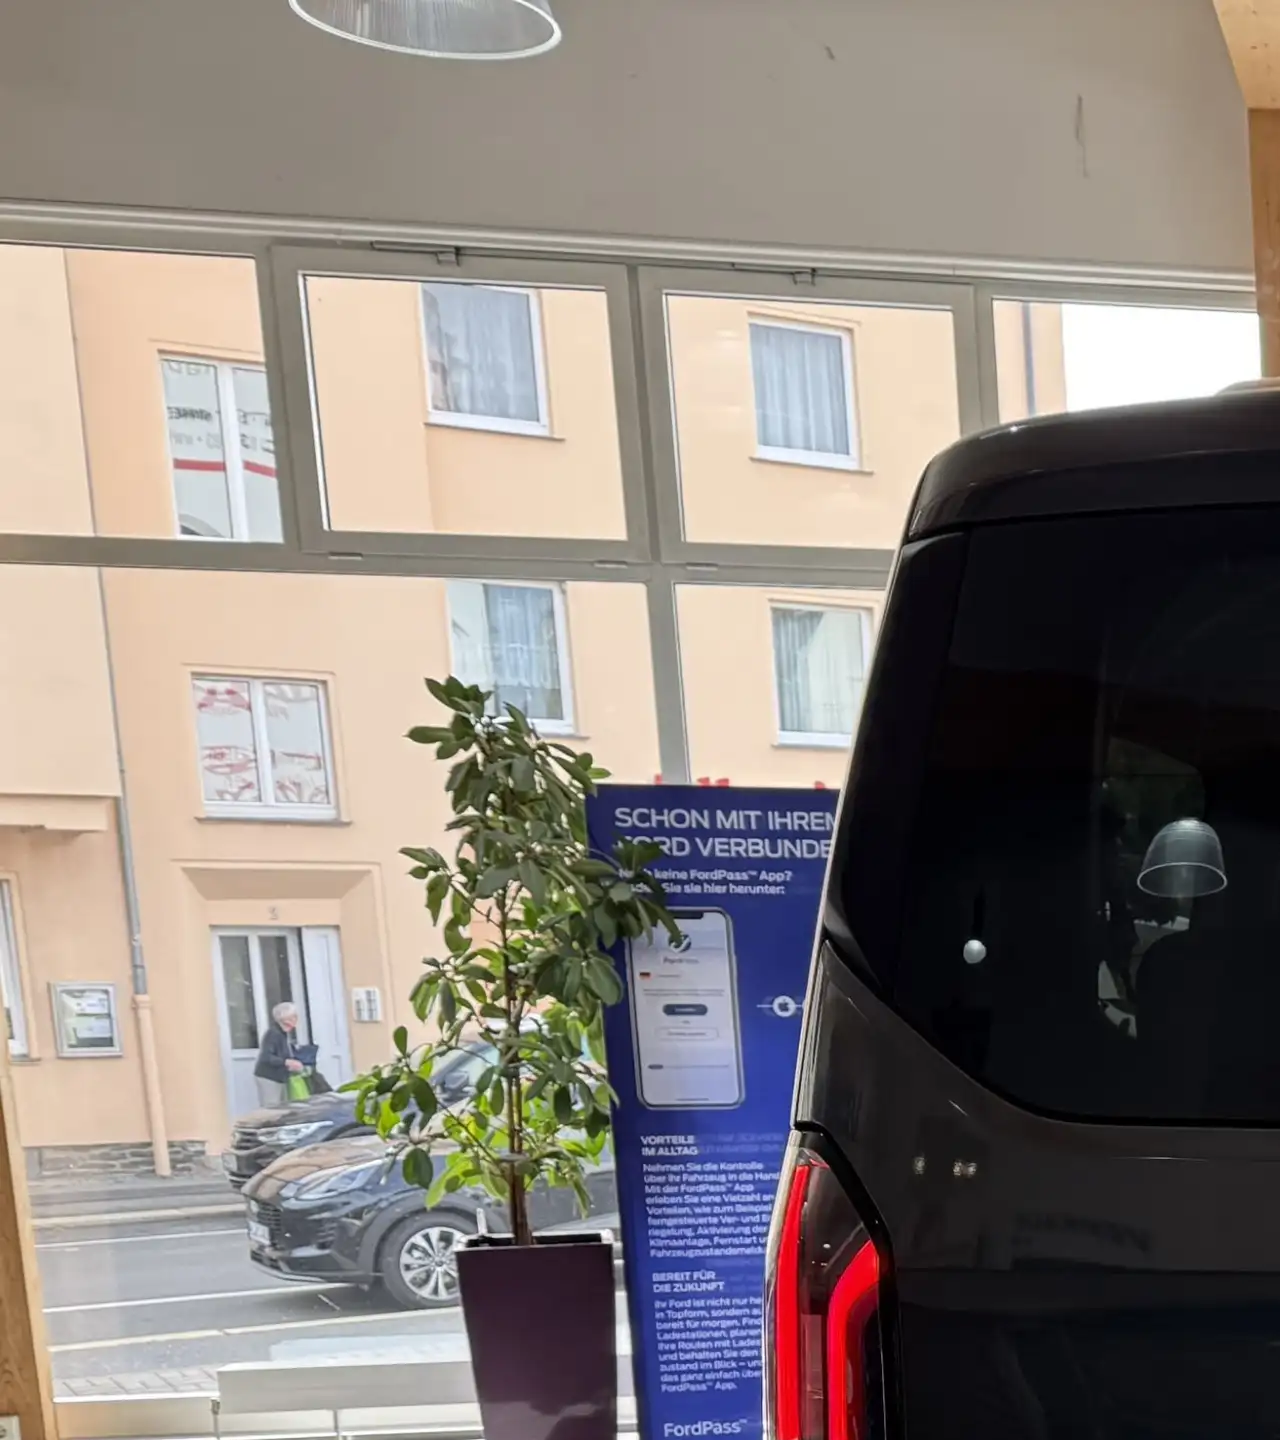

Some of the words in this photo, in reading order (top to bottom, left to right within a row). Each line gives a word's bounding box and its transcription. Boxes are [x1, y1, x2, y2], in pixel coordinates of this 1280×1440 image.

[615, 808, 710, 829] SCHON
[716, 809, 762, 830] MIT
[695, 837, 832, 858] VERBUNDE
[655, 869, 687, 880] keine
[759, 871, 792, 882] App?
[662, 883, 681, 893] Sie
[684, 884, 701, 894] sie
[703, 883, 727, 893] hier
[640, 1135, 695, 1145] VORTEILE
[642, 1147, 655, 1156] IM
[657, 1146, 698, 1156] ALLTAG
[652, 1271, 691, 1281] BEREIT
[693, 1269, 716, 1280] FÜR
[653, 1283, 671, 1293] DIE
[673, 1281, 725, 1292] ZUKUNFT
